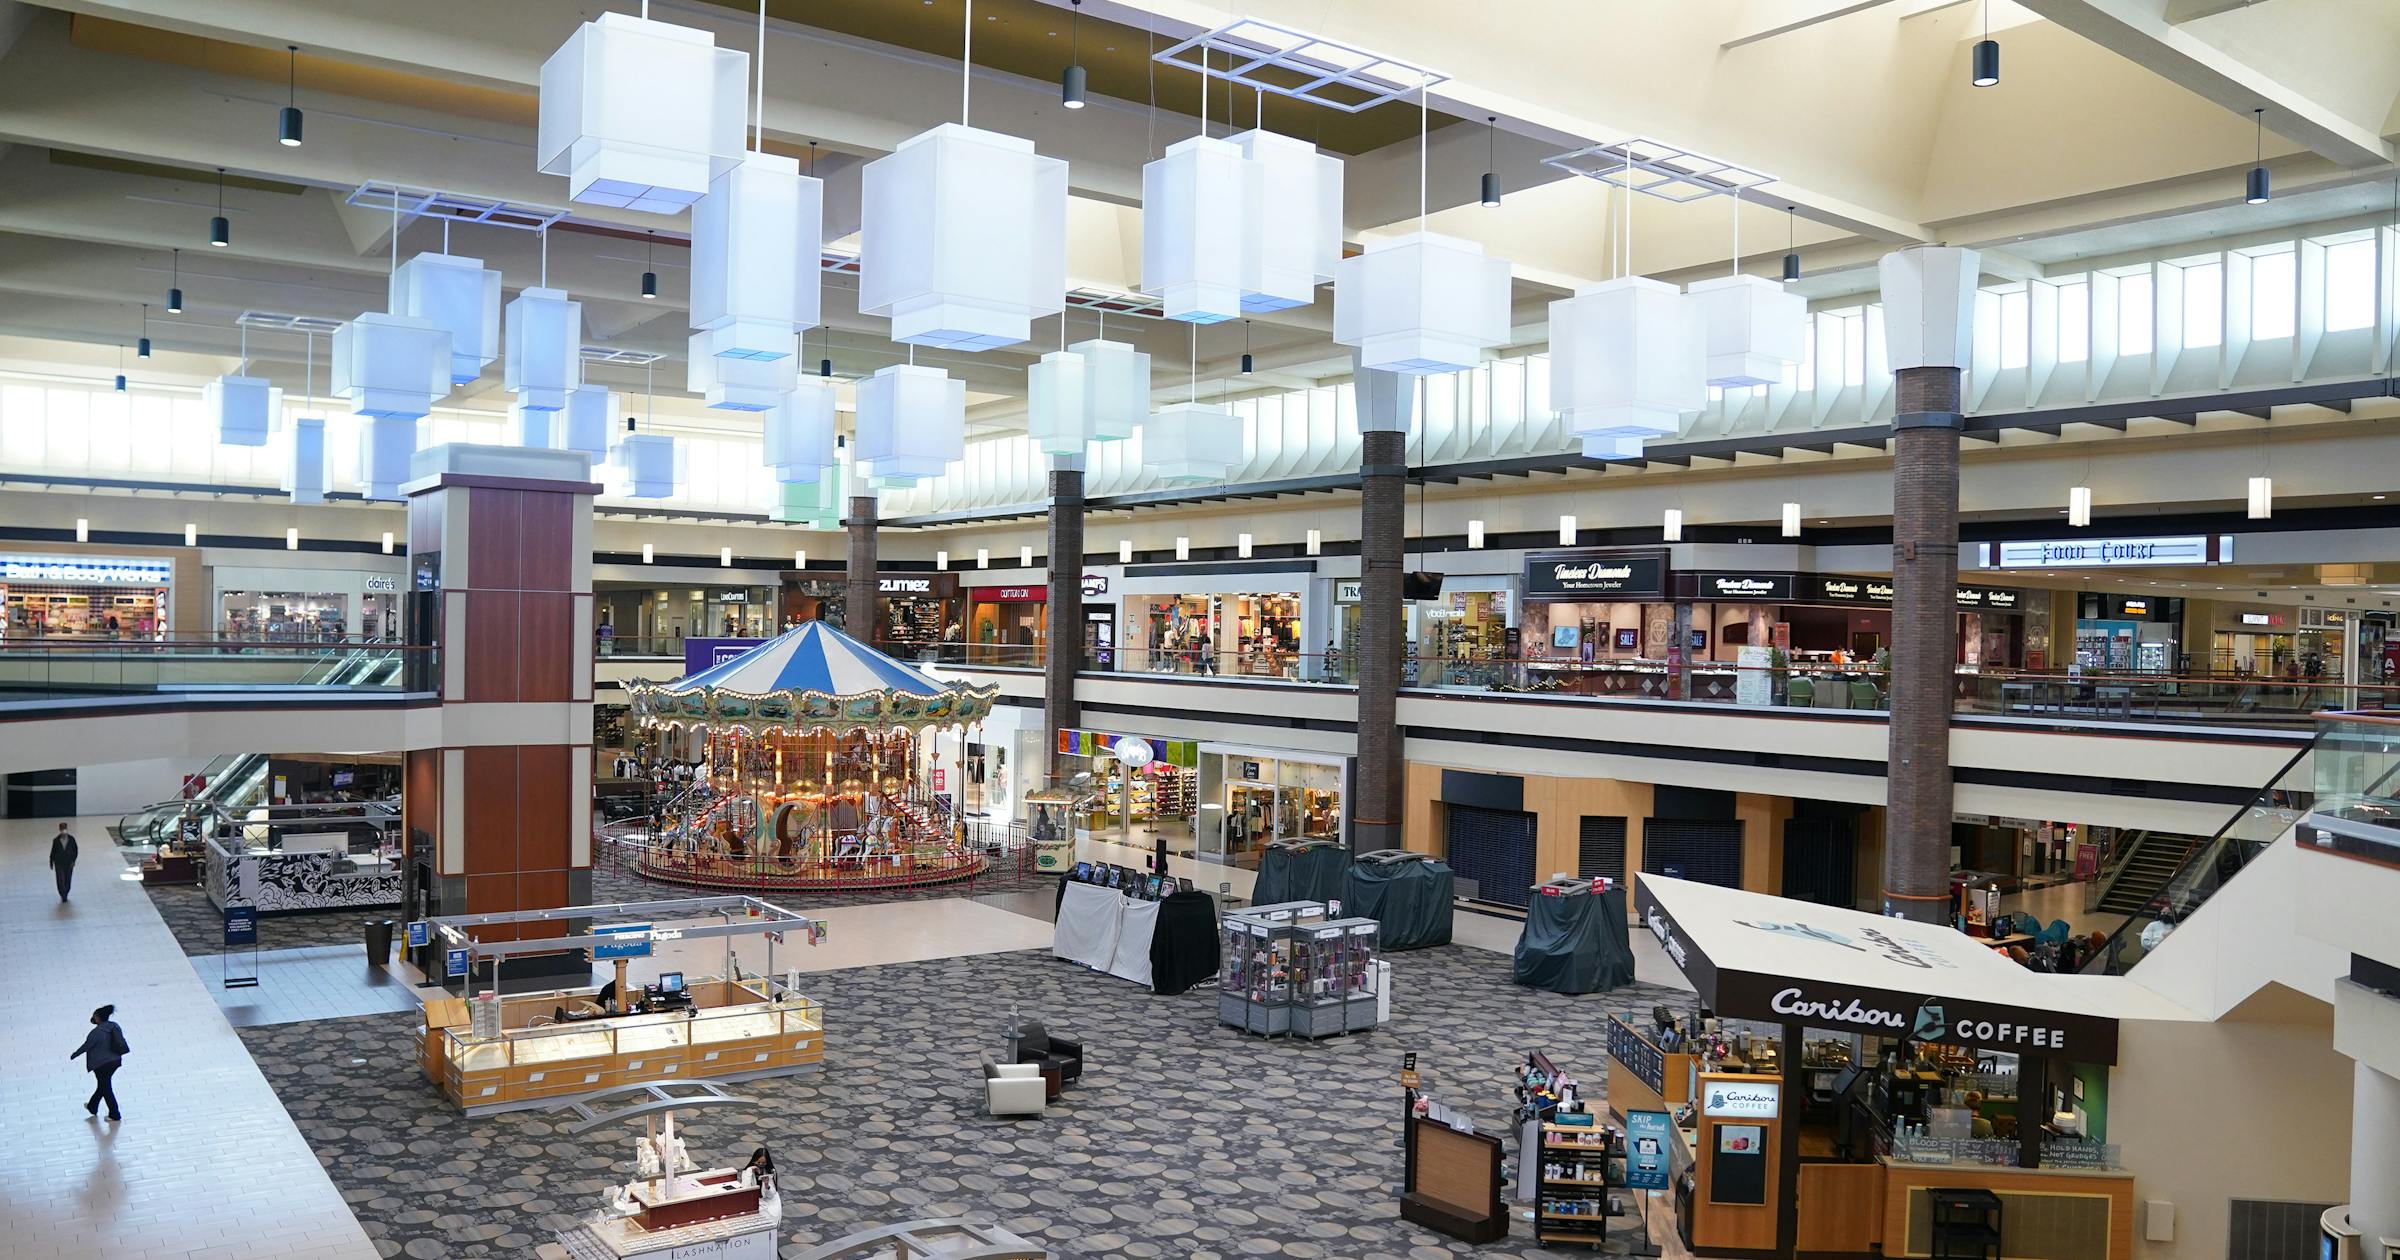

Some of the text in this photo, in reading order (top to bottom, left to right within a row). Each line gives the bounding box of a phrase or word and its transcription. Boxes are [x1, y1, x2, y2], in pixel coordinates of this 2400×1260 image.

[2041, 541, 2155, 564] FOOD COURT
[1554, 562, 1632, 580] Timeless Diamonds
[879, 579, 930, 592] zumiez
[1619, 634, 1634, 645] SALE
[650, 929, 682, 941] Pagoda
[1771, 988, 1905, 1028] Caribou
[1956, 1019, 2064, 1048] COFFEE
[1726, 1091, 1776, 1102] Caribou
[1632, 1114, 1653, 1125] SKIP
[1909, 1138, 1938, 1147] BLOOD
[2049, 1144, 2071, 1152] HOLD
[2049, 1151, 2064, 1159] NOT
[676, 1239, 752, 1260] LASHNATION
